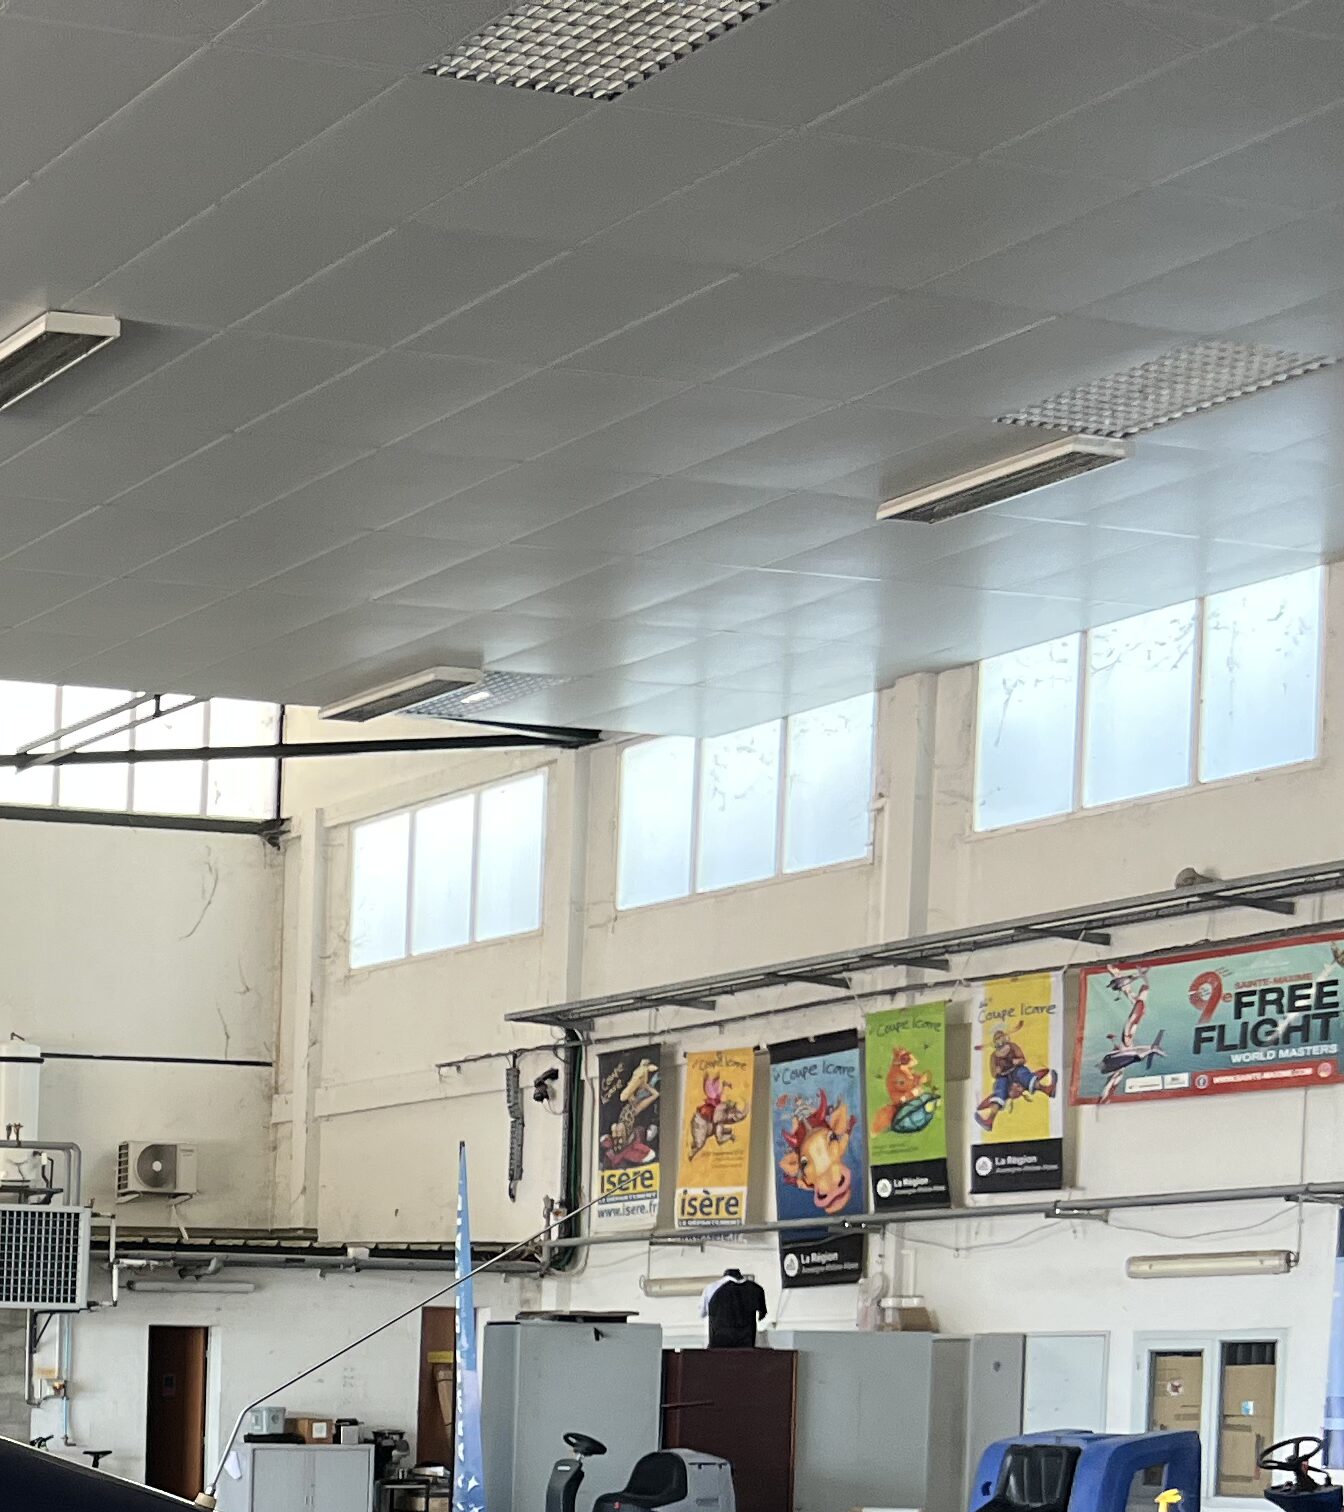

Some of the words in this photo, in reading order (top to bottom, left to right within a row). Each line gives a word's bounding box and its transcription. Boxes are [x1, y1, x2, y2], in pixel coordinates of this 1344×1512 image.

[1234, 979, 1340, 1020] FREE
[978, 1007, 1016, 1024] Coupe
[1021, 1002, 1057, 1016] Icare
[877, 1020, 909, 1037] Coupe
[912, 1016, 942, 1033] Icare
[1192, 1011, 1340, 1055] FLIGHT
[1230, 1049, 1276, 1064] WORLD
[1279, 1043, 1338, 1060] MASTERS
[782, 1064, 817, 1085] Coupe
[822, 1061, 855, 1078] Icare
[597, 1200, 657, 1218] www.isere.fr
[681, 1189, 740, 1217] isère
